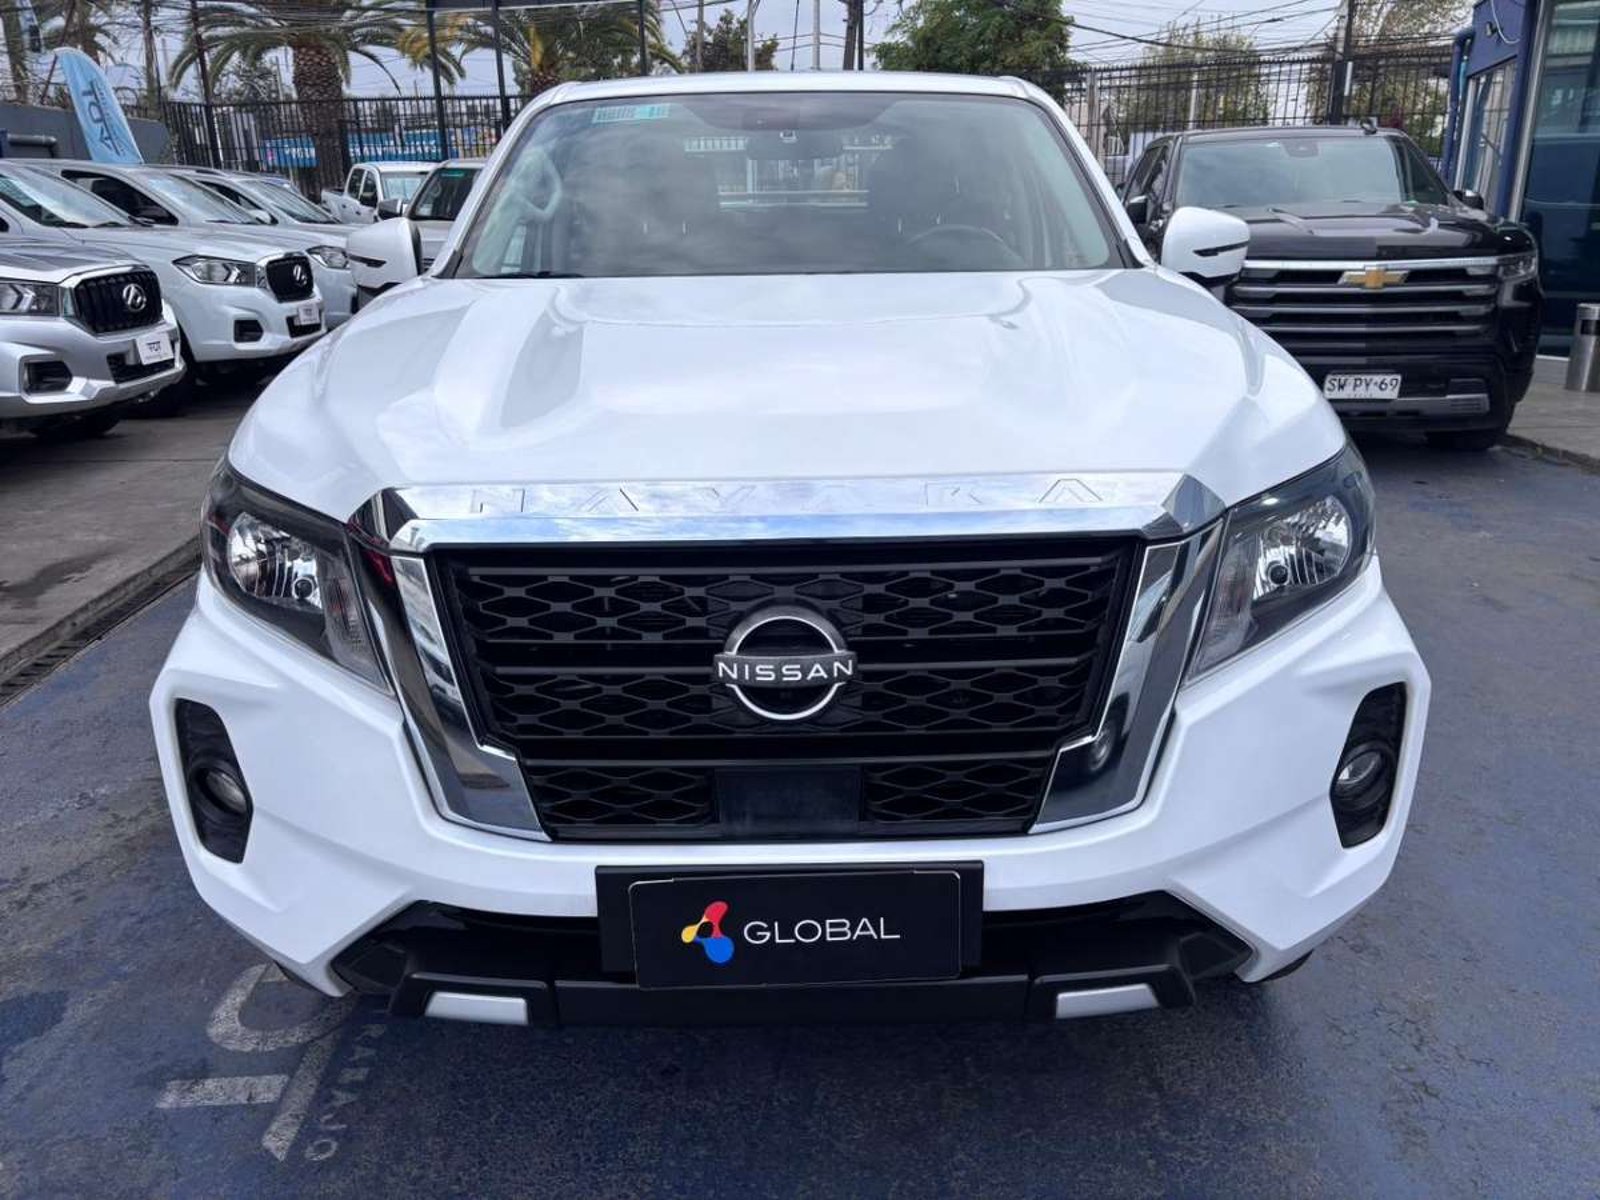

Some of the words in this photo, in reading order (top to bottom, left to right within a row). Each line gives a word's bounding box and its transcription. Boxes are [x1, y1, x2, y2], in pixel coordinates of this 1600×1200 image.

[1327, 378, 1348, 392] SW
[718, 659, 853, 681] NISSAN
[743, 917, 900, 944] GLOBAL
